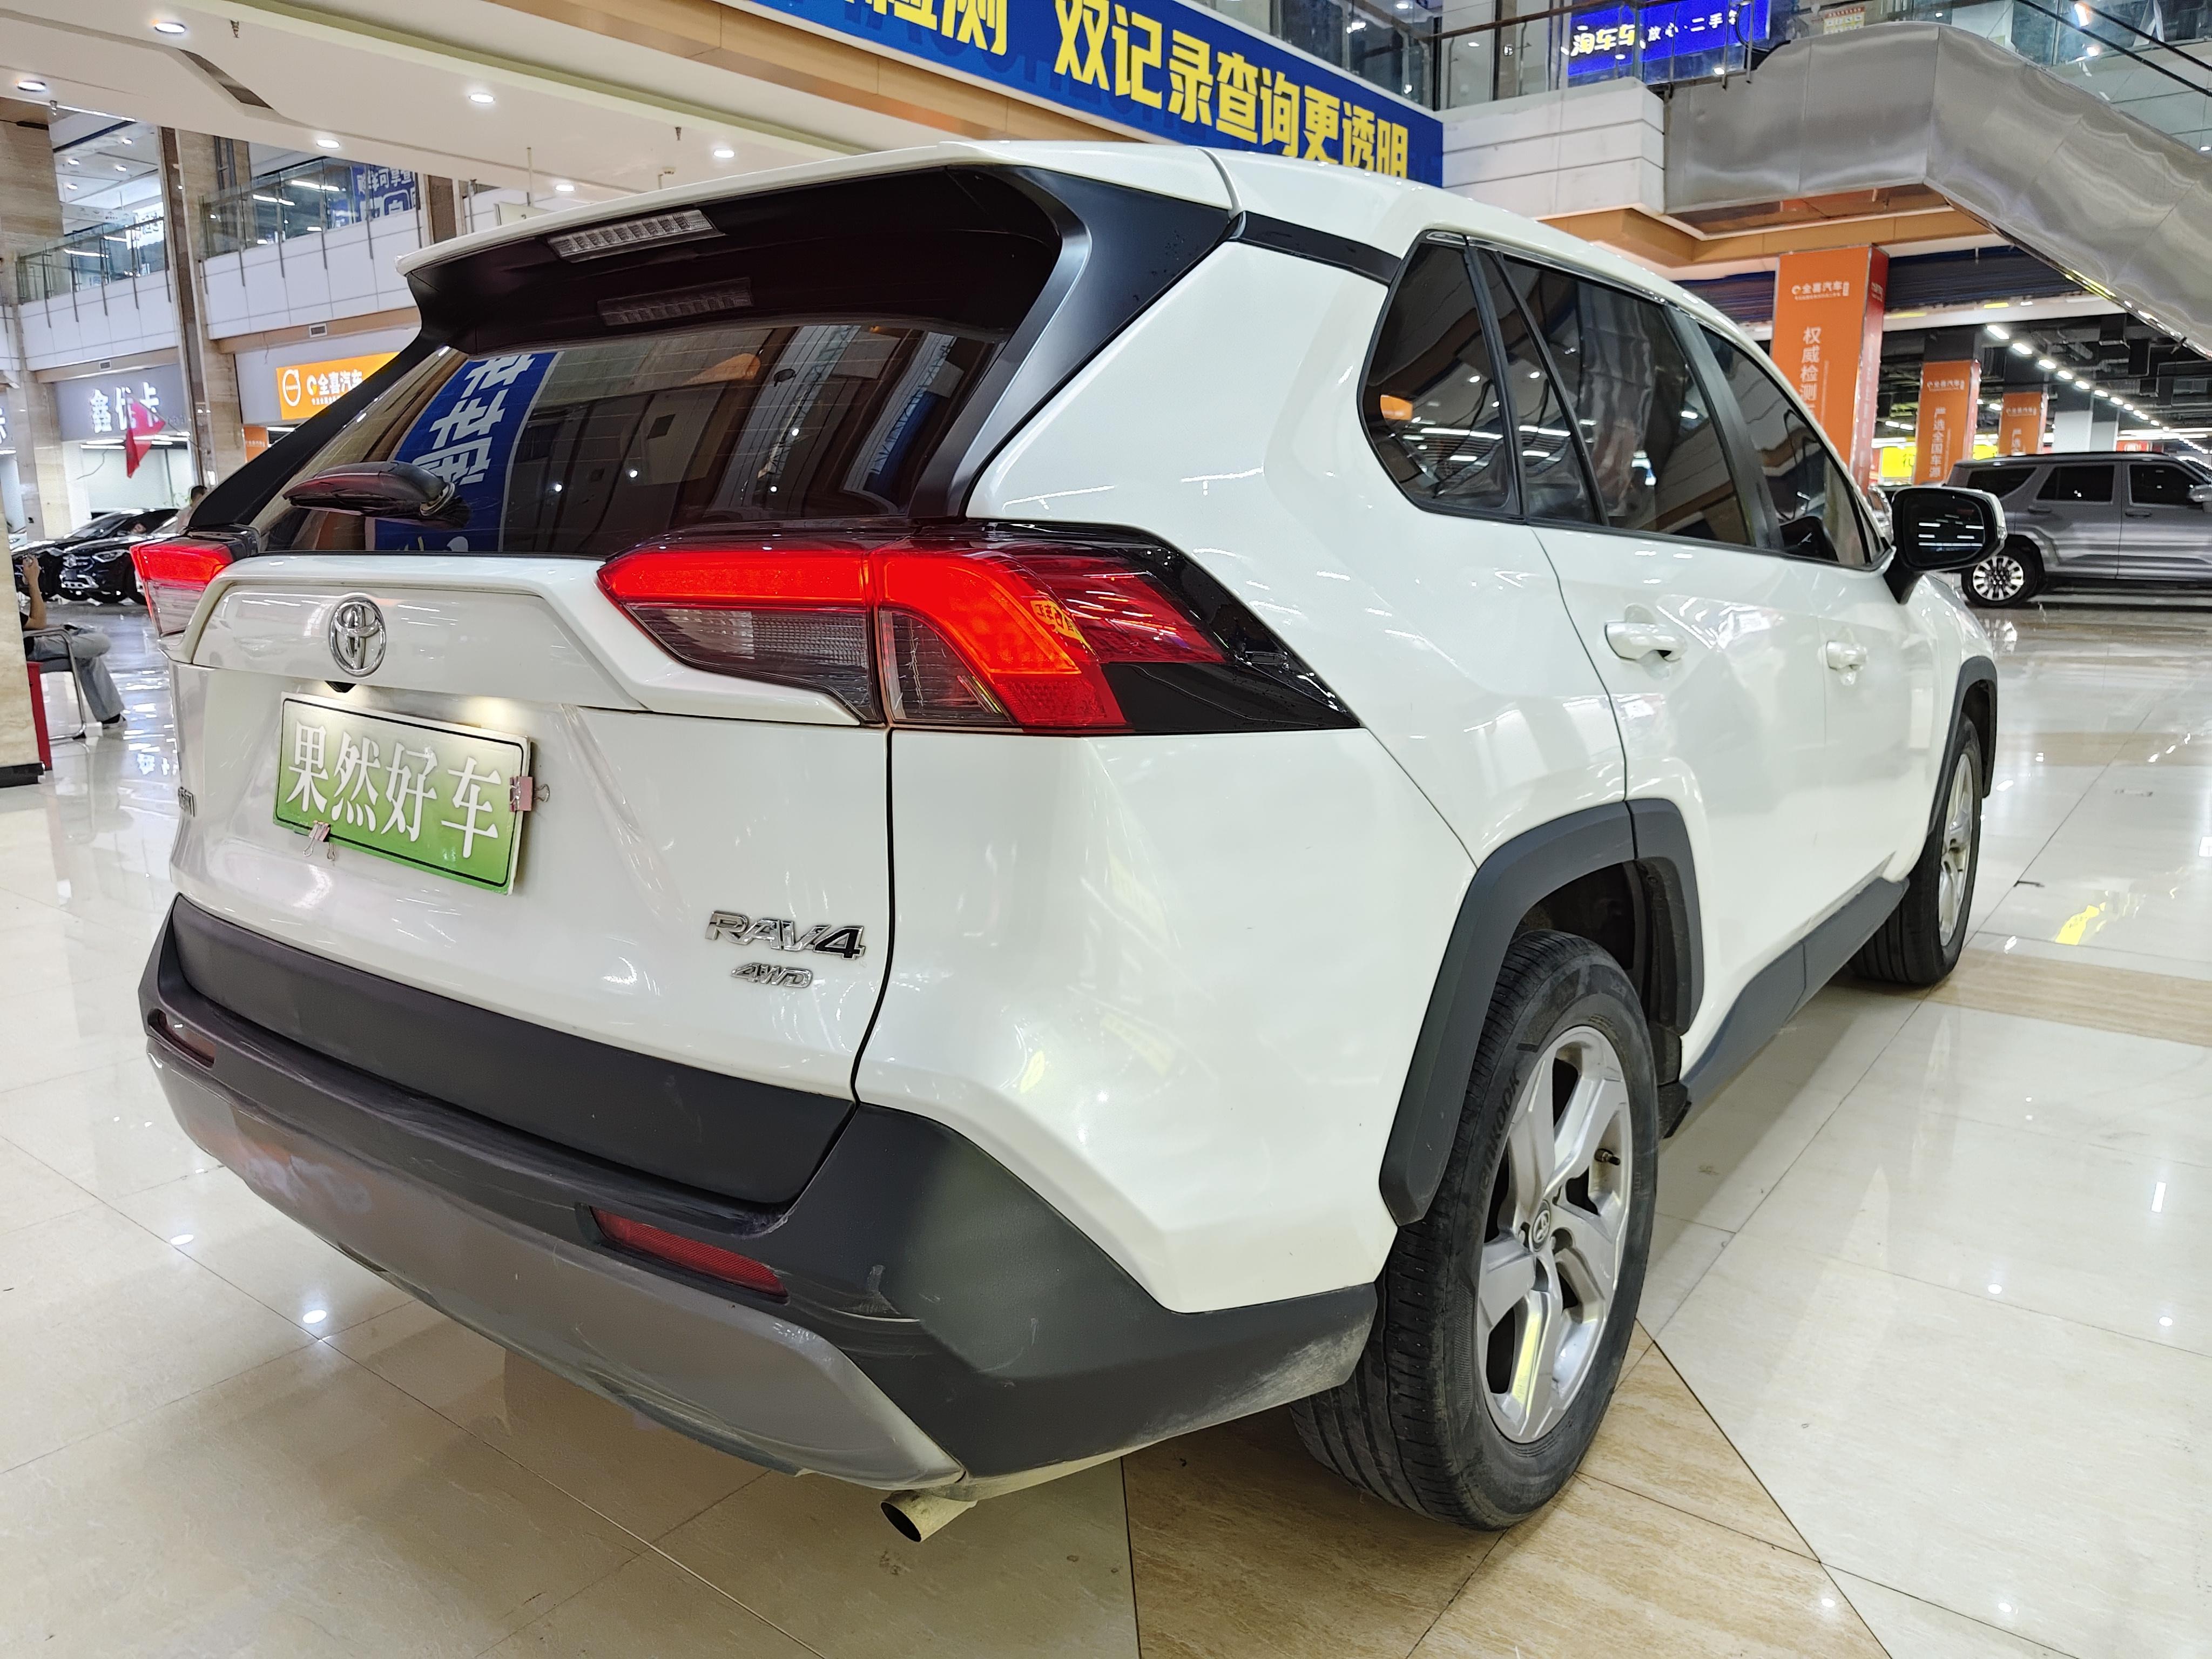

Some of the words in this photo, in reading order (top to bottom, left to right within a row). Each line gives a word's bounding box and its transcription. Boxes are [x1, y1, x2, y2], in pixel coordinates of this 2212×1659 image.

[1054, 0, 1408, 179] 双记录查询更透明
[317, 369, 362, 396] 全喜汽车
[286, 721, 502, 858] 果然好车
[705, 911, 866, 960] RAV4
[731, 962, 813, 988] 4WD
